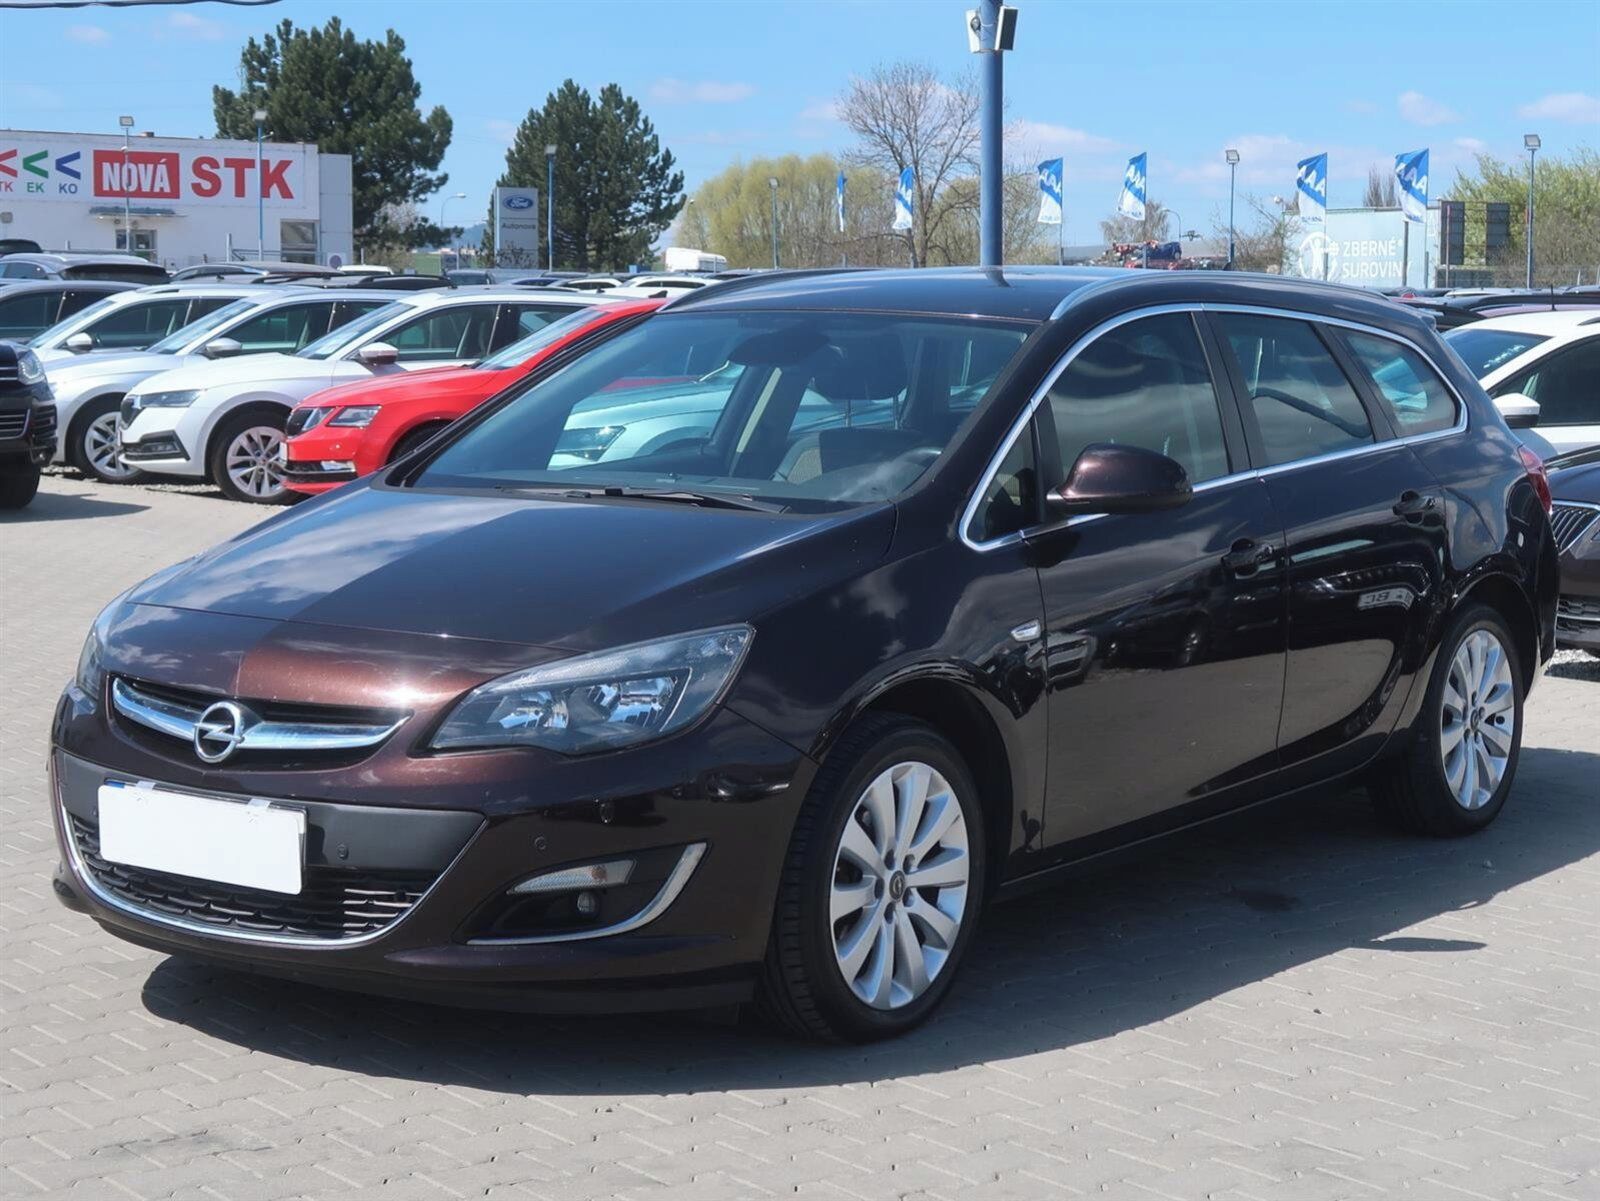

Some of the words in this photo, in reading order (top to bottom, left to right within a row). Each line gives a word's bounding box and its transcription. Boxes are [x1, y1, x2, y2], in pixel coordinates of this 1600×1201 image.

[26, 181, 45, 193] EK
[59, 183, 78, 194] KO
[102, 158, 171, 193] NOVÁ
[191, 156, 294, 199] STK
